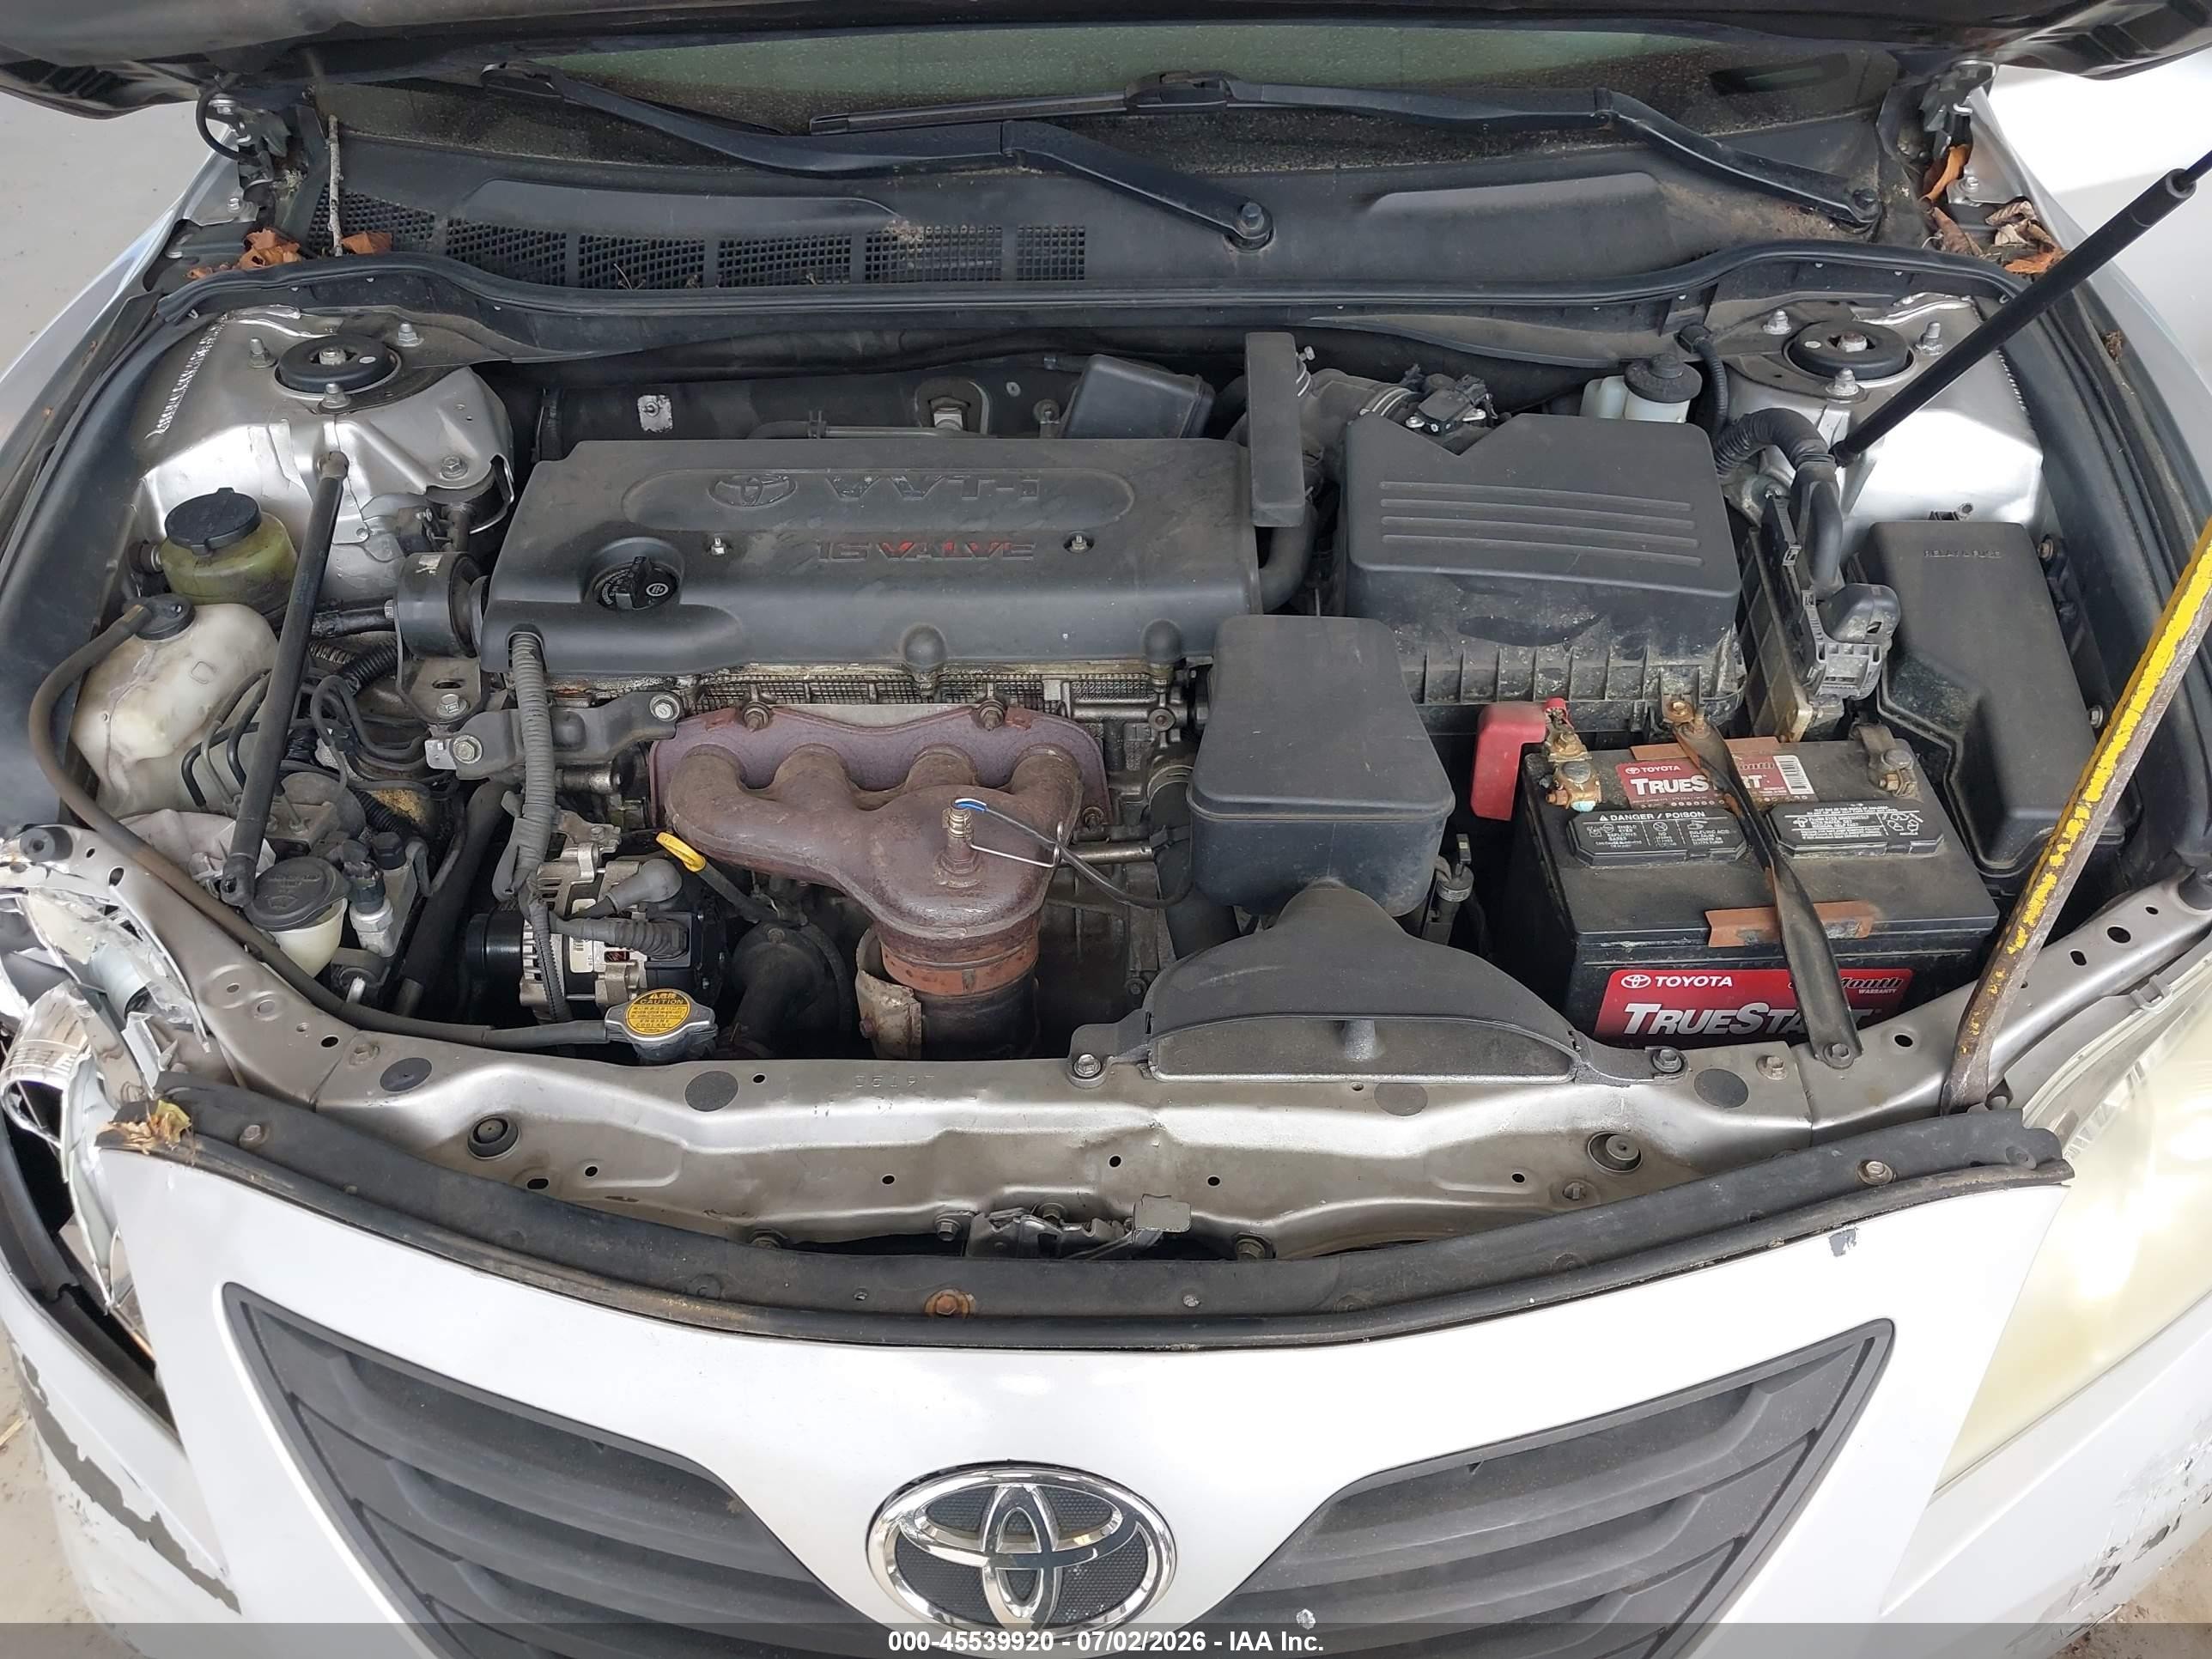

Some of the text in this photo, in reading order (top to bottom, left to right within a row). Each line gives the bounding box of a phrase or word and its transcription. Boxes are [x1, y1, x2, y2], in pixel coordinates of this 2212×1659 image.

[1610, 812, 1655, 821] DANGER
[1667, 811, 1706, 819] POISON
[1656, 975, 1733, 988] TOYOTA
